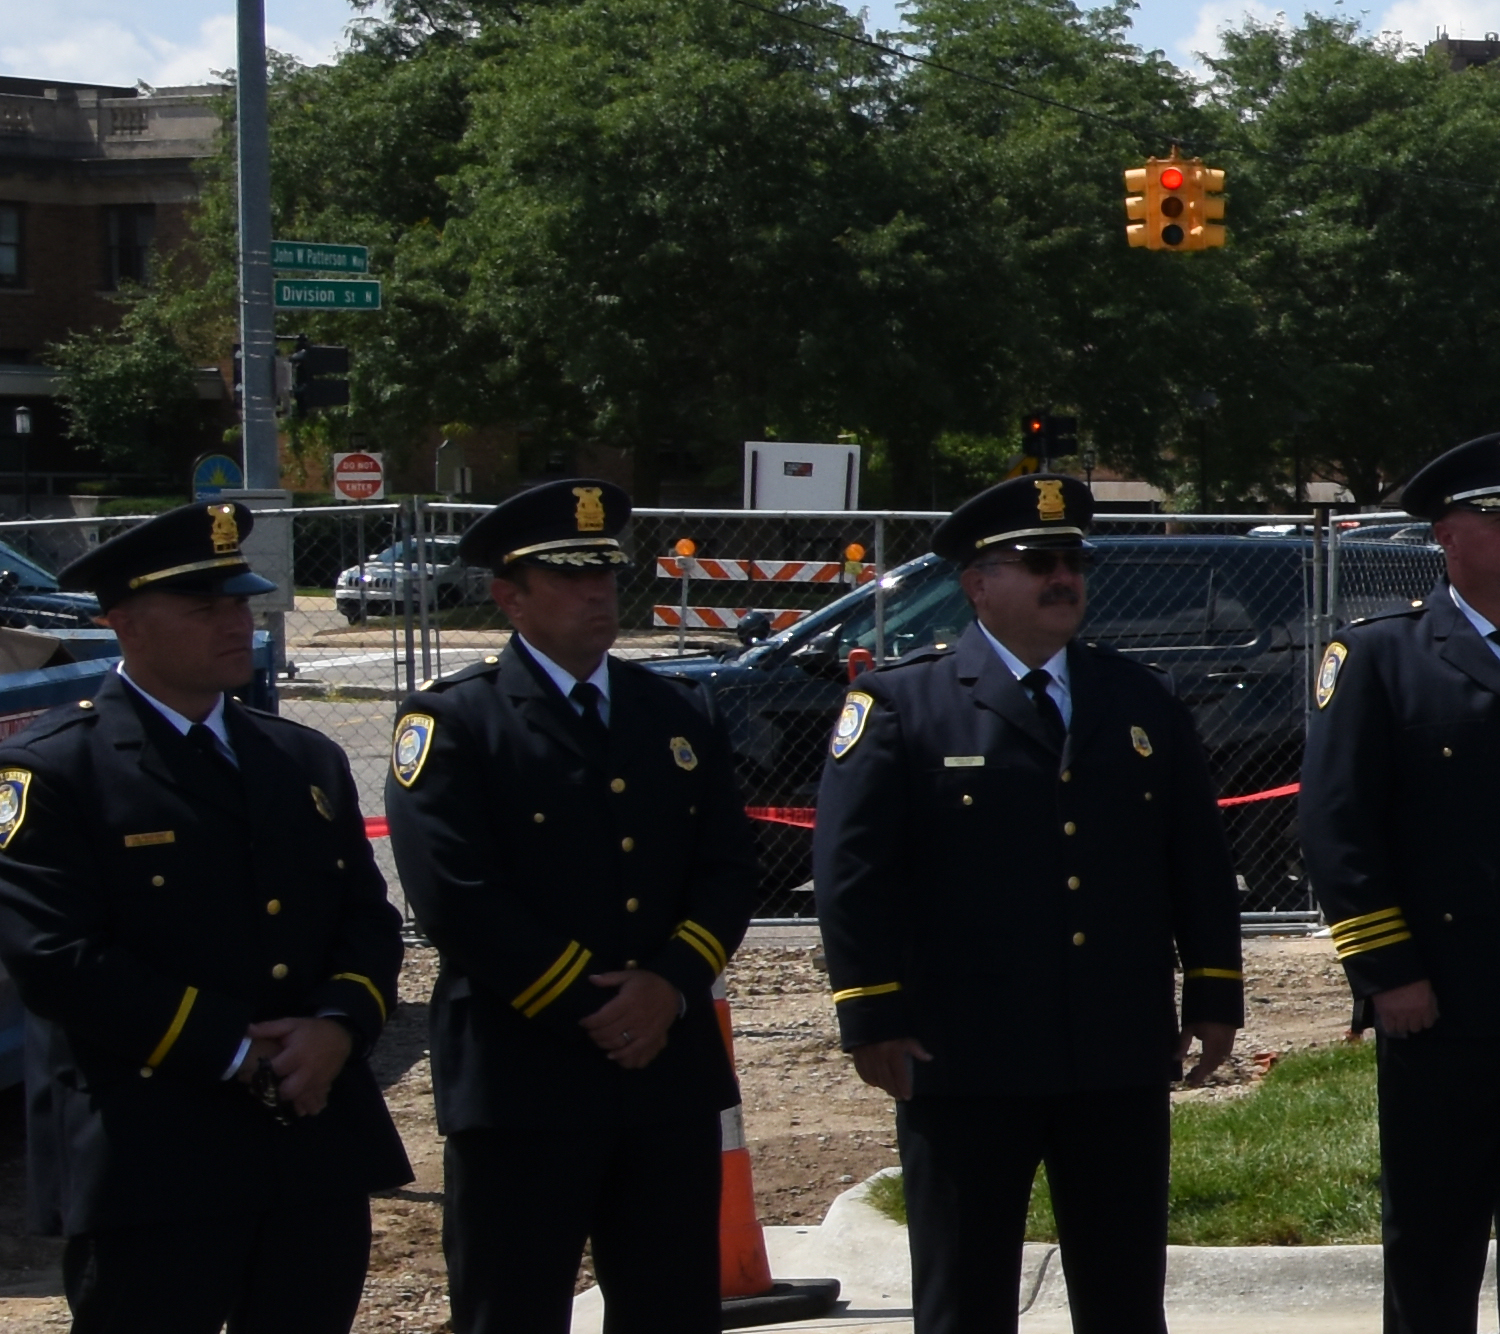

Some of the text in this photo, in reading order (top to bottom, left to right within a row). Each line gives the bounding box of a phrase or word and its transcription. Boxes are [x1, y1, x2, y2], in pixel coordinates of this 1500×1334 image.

[274, 247, 294, 264] John
[297, 249, 304, 264] W
[307, 249, 347, 267] Patterson
[283, 285, 373, 303] Division St N
[343, 461, 374, 470] DO NOT
[346, 483, 373, 492] ENTER
